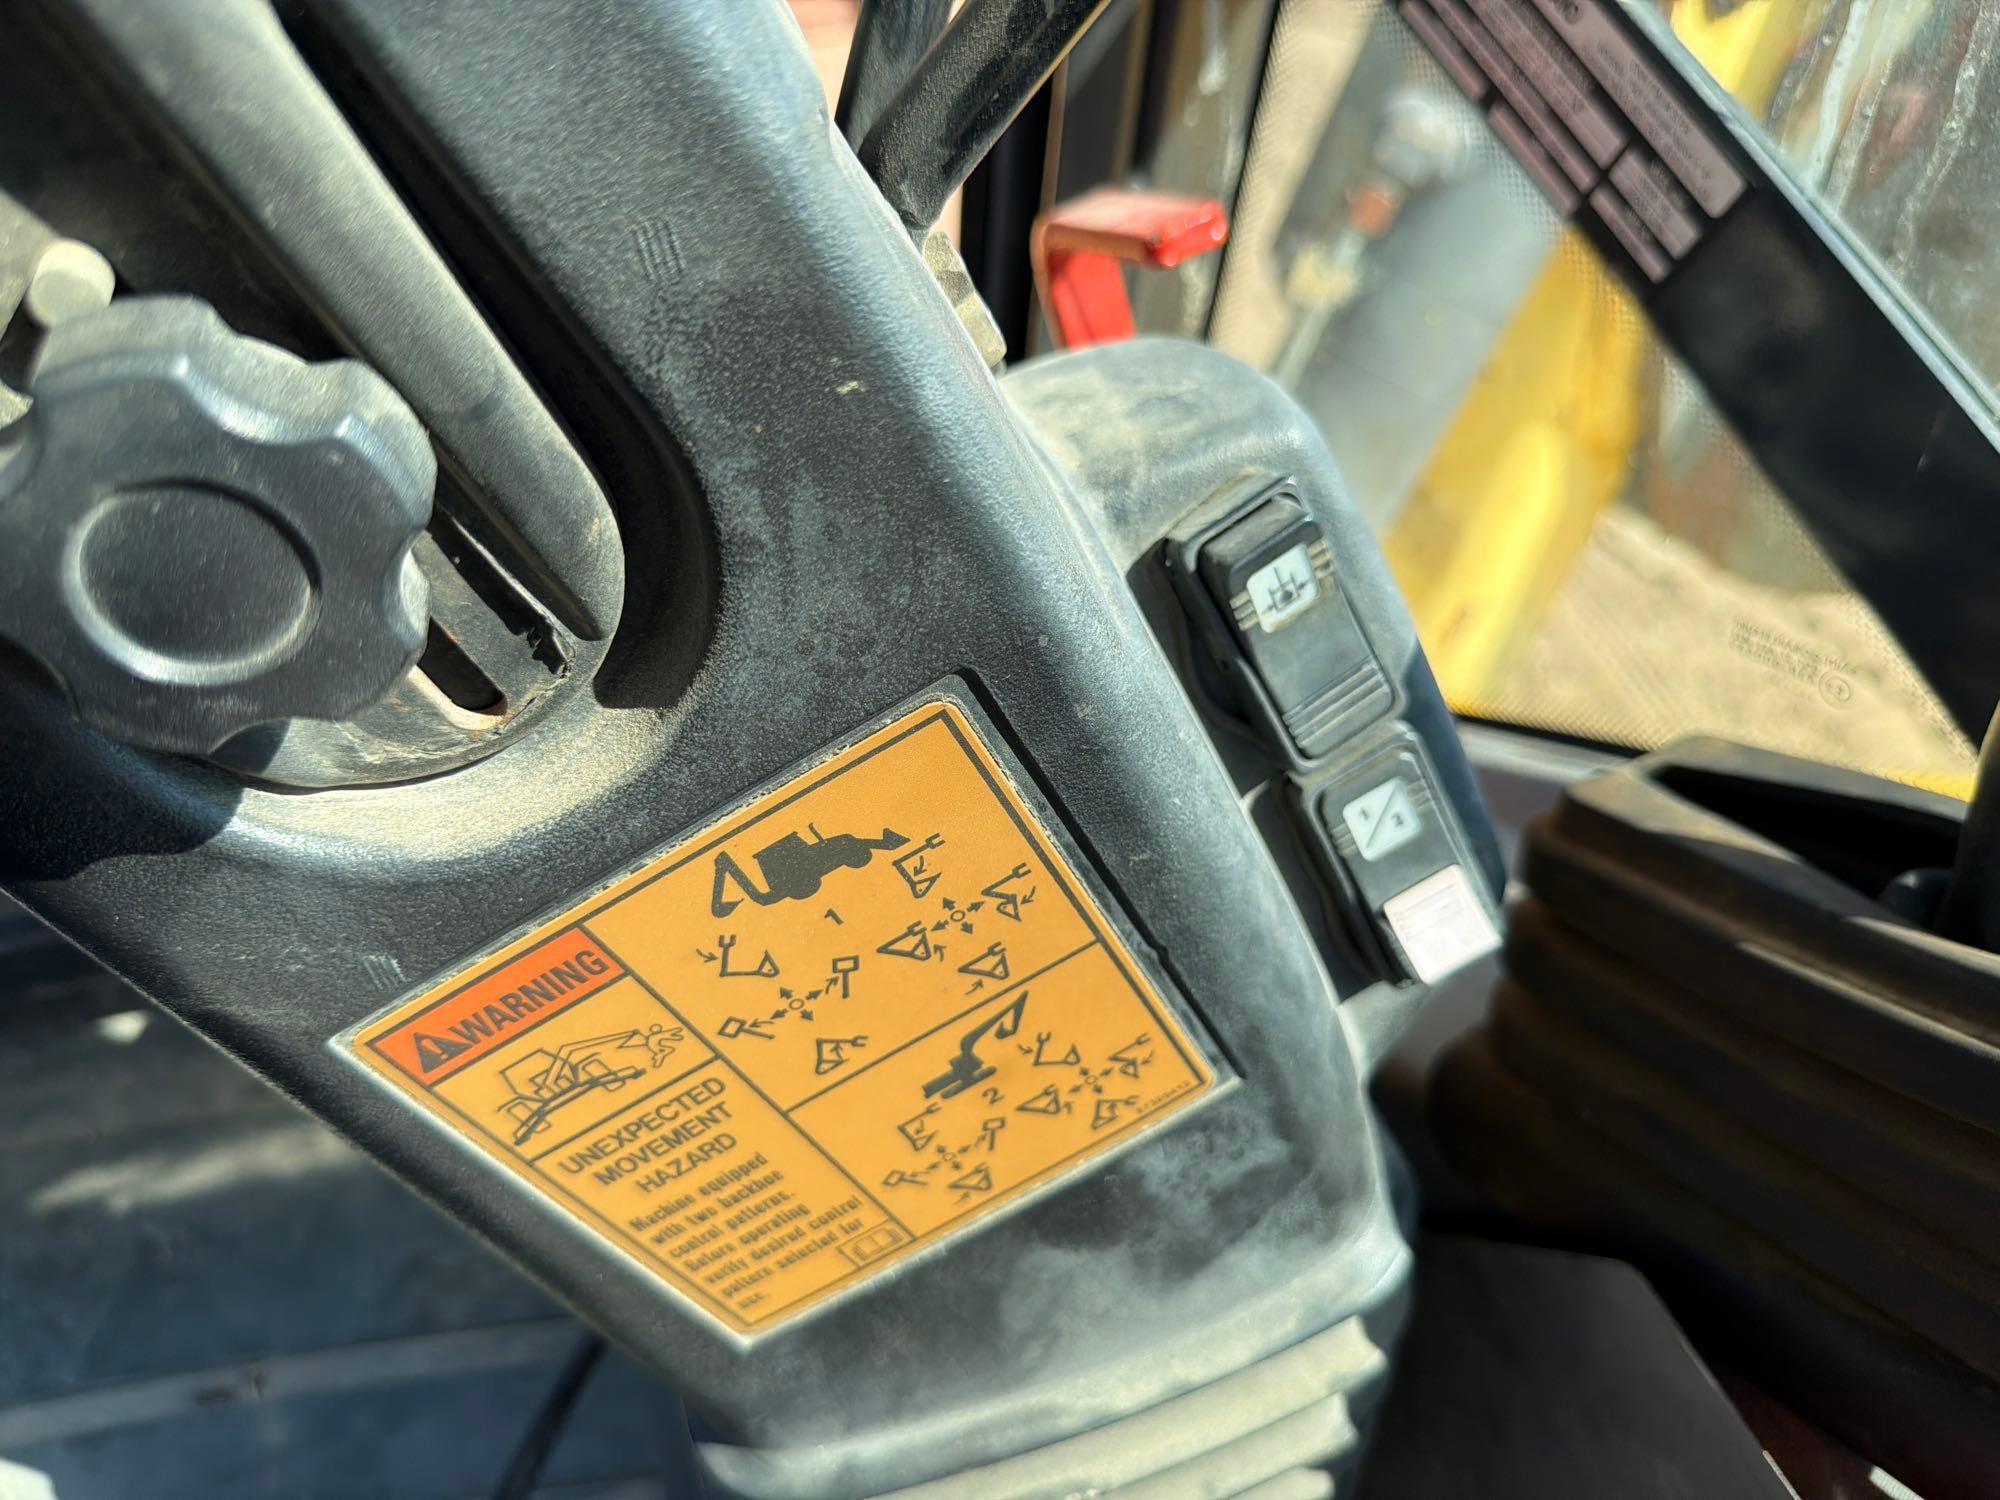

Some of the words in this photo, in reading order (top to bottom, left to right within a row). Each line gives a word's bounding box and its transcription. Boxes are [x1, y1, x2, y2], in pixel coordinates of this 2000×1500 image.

[824, 908, 844, 926] 1
[448, 950, 610, 1045] WARNING
[558, 1077, 726, 1174] UNEXPECTED
[982, 1087, 1006, 1105] 2
[593, 1101, 733, 1185] MOVEMENT
[635, 1133, 737, 1193] HAZARD
[628, 1193, 697, 1233] Machine
[698, 1151, 769, 1197] equipped
[652, 1222, 687, 1245] with
[686, 1206, 718, 1226] two
[716, 1169, 784, 1209] backhoe
[669, 1224, 724, 1258] control
[725, 1190, 797, 1231] patterns.
[684, 1240, 737, 1273] Before
[738, 1203, 811, 1247] operating
[704, 1257, 749, 1285] verify
[750, 1227, 807, 1262] desired
[807, 1195, 863, 1230] control
[720, 1267, 774, 1299] pattern
[776, 1233, 839, 1269] selected
[841, 1217, 865, 1236] for
[736, 1292, 771, 1309] use.
